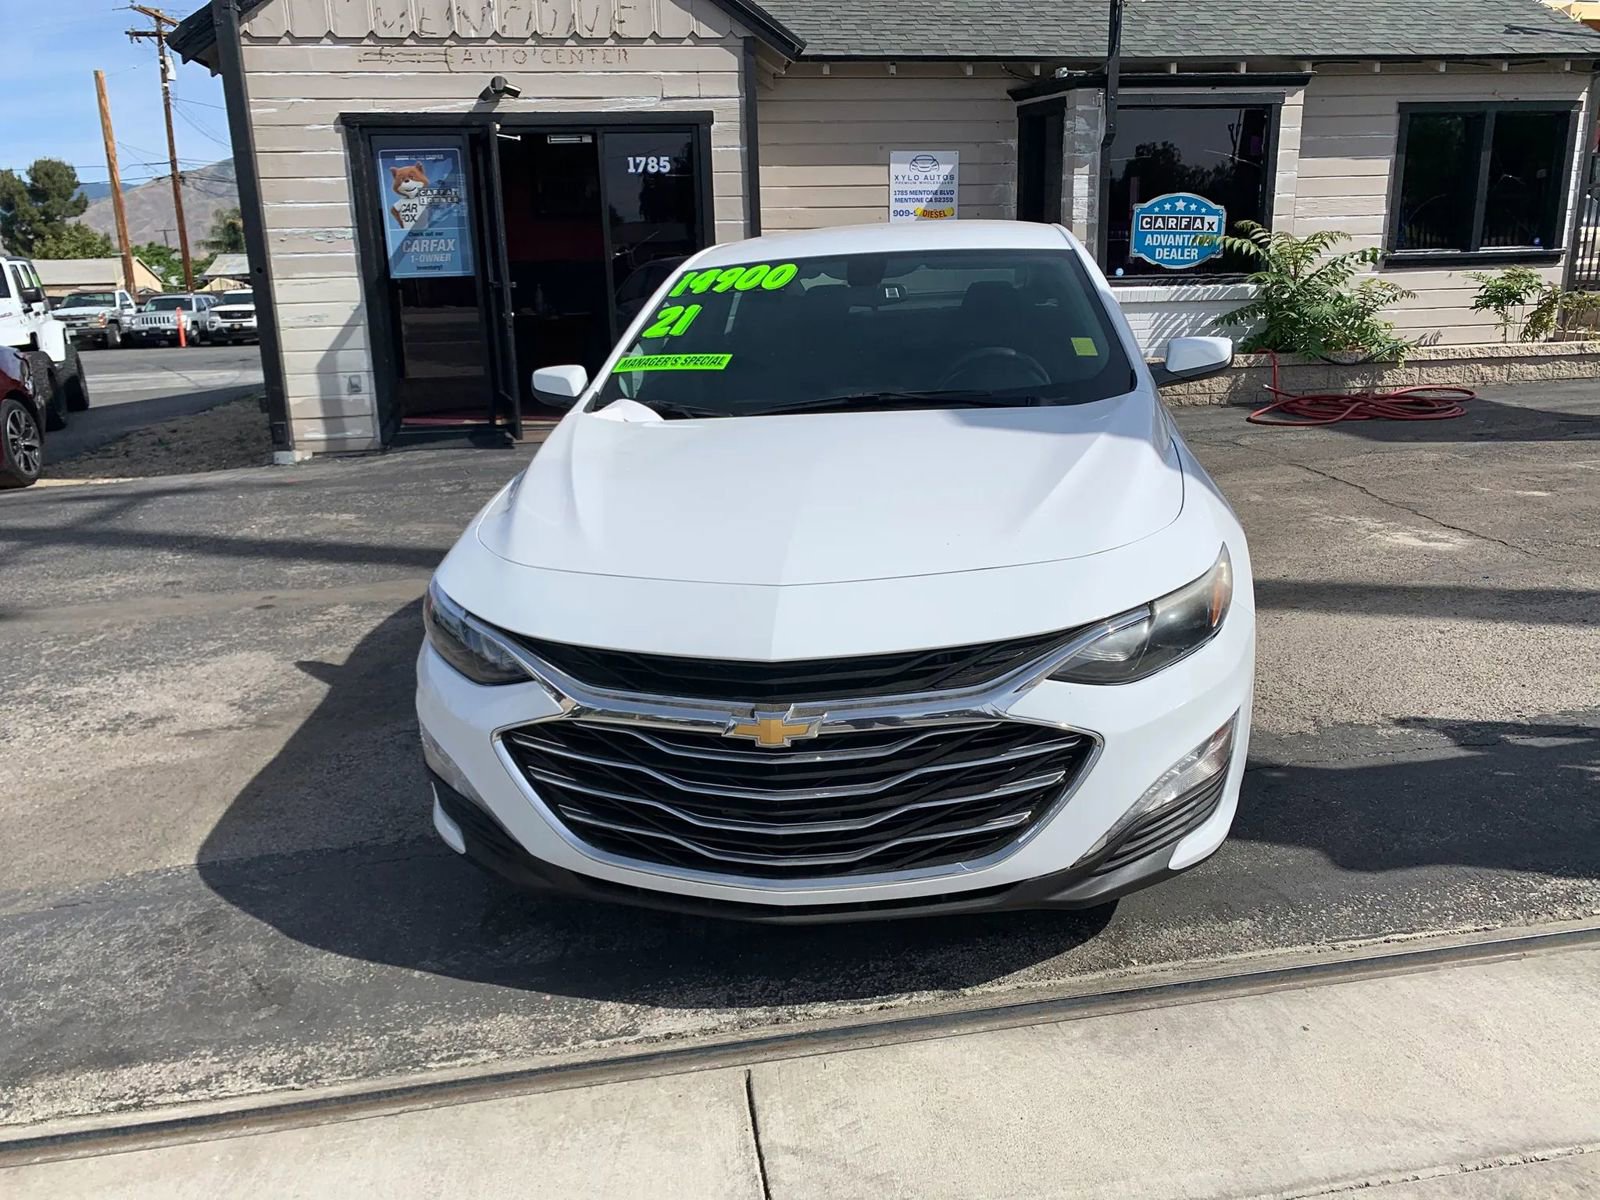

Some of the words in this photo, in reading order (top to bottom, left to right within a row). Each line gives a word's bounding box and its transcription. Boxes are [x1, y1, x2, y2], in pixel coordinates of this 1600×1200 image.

[540, 48, 629, 65] CENTER
[627, 156, 671, 173] 1785
[401, 203, 418, 213] CAR
[922, 209, 947, 219] DIESEL
[1141, 216, 1217, 231] CARFAX
[402, 239, 456, 252] CARFAX
[410, 253, 452, 263] 1-OWNER
[1155, 248, 1198, 260] DEALER
[668, 263, 798, 297] 14900
[641, 304, 703, 338] 21
[622, 356, 679, 368] MANAGER'S
[680, 355, 725, 367] SPECIAL
